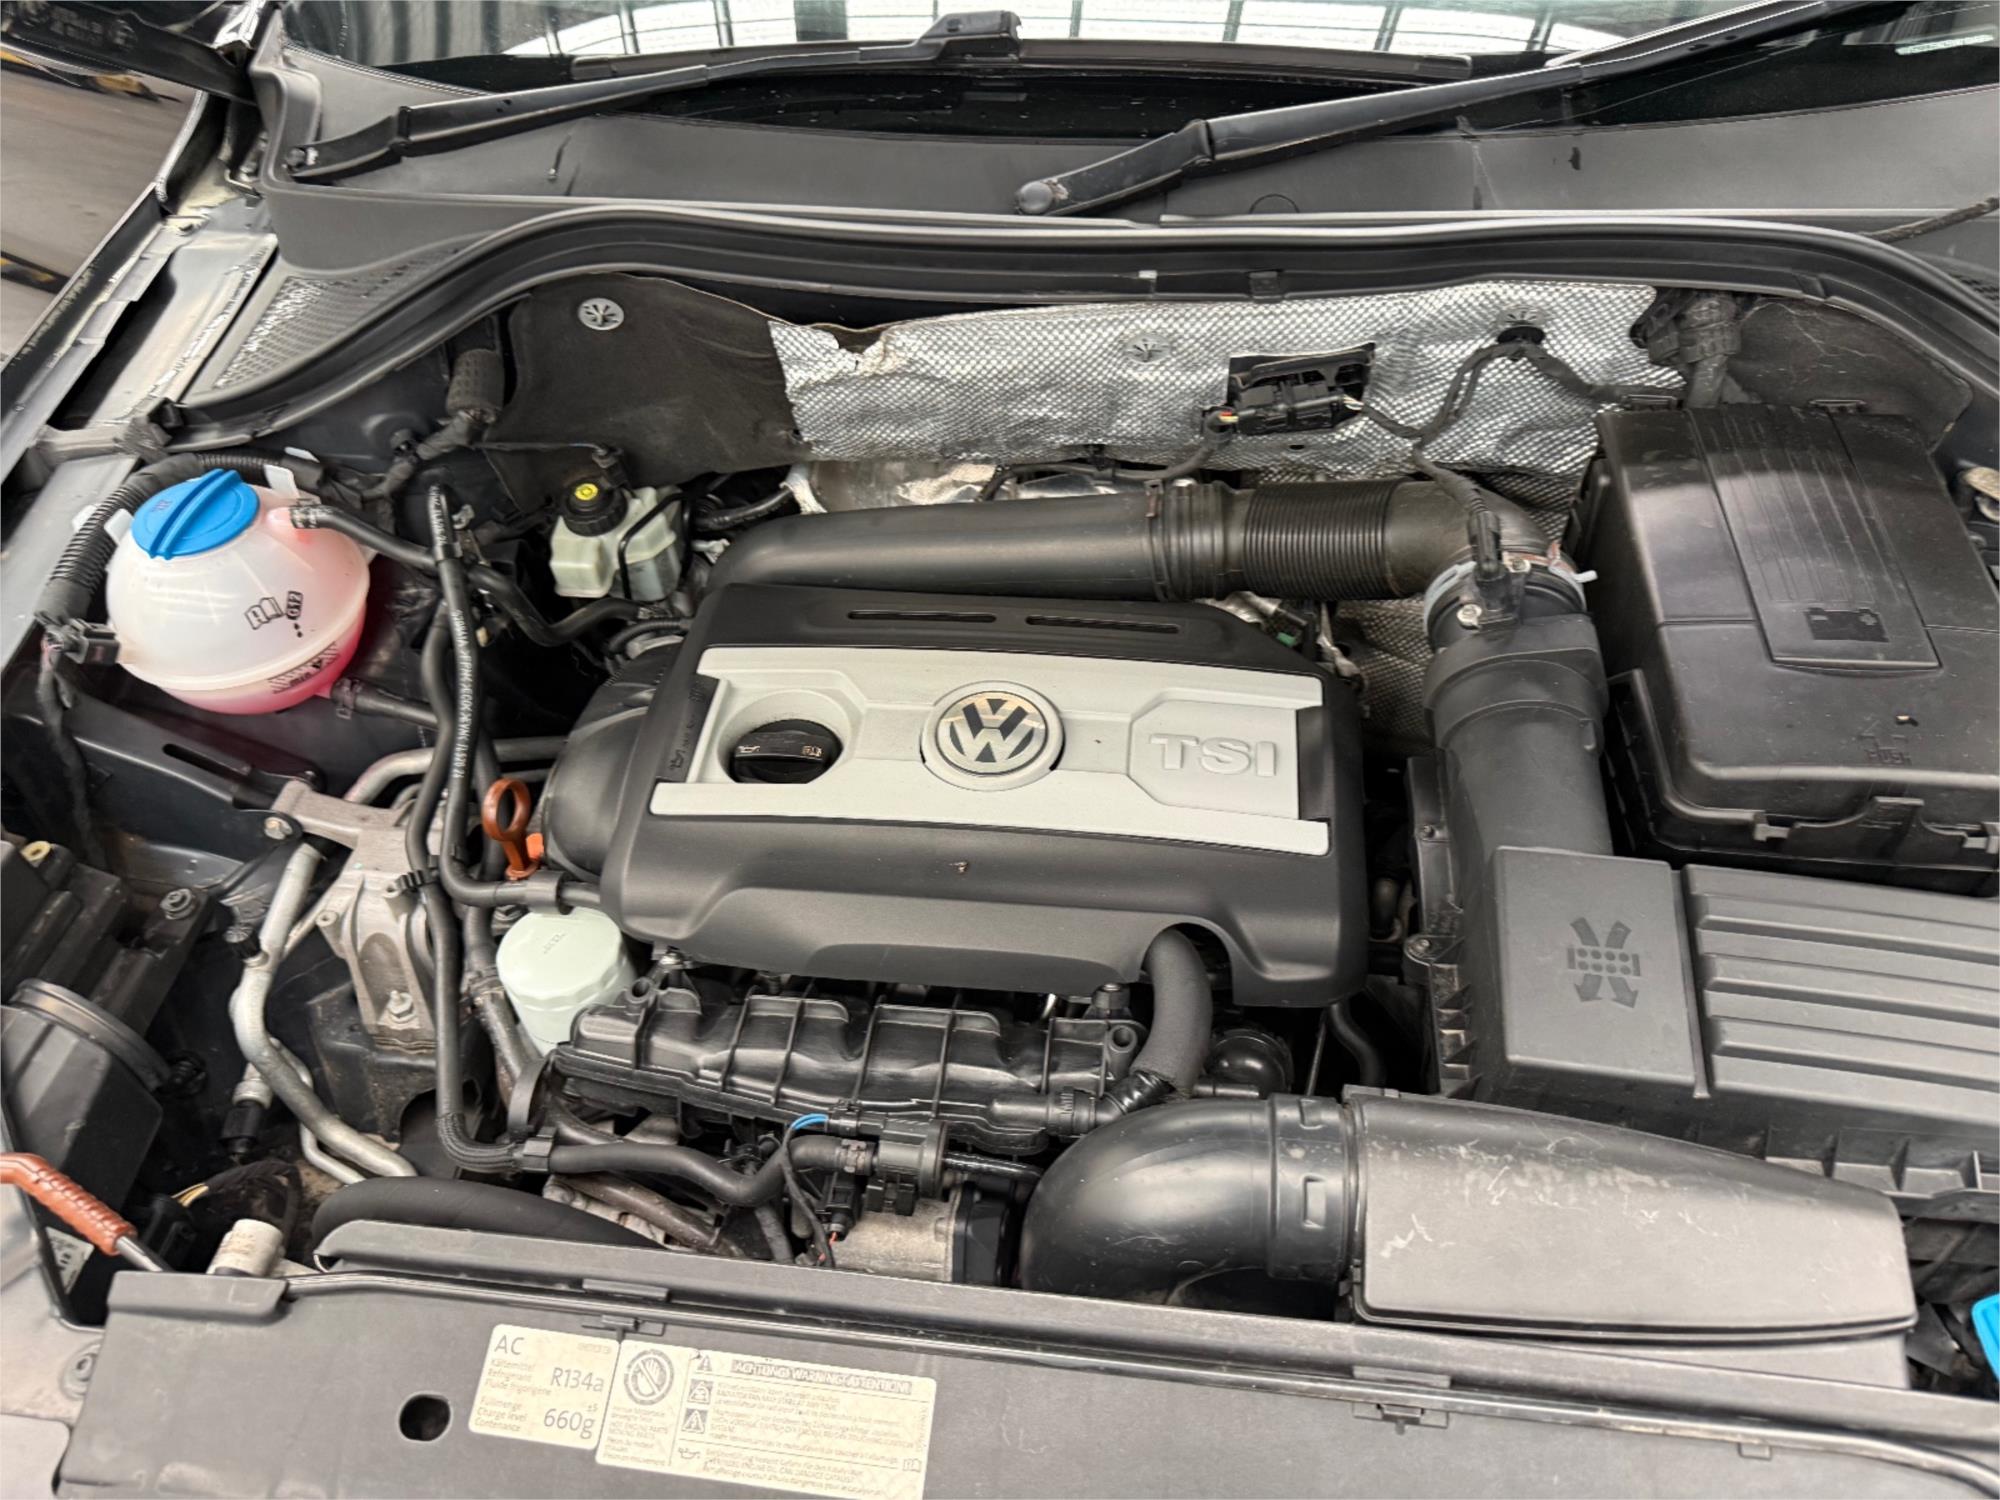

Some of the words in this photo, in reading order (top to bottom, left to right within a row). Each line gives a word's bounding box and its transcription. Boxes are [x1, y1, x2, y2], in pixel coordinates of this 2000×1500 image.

[1149, 733, 1277, 777] TSI
[494, 1334, 525, 1355] AC
[549, 1366, 606, 1393] R134a
[543, 1408, 597, 1440] 660g
